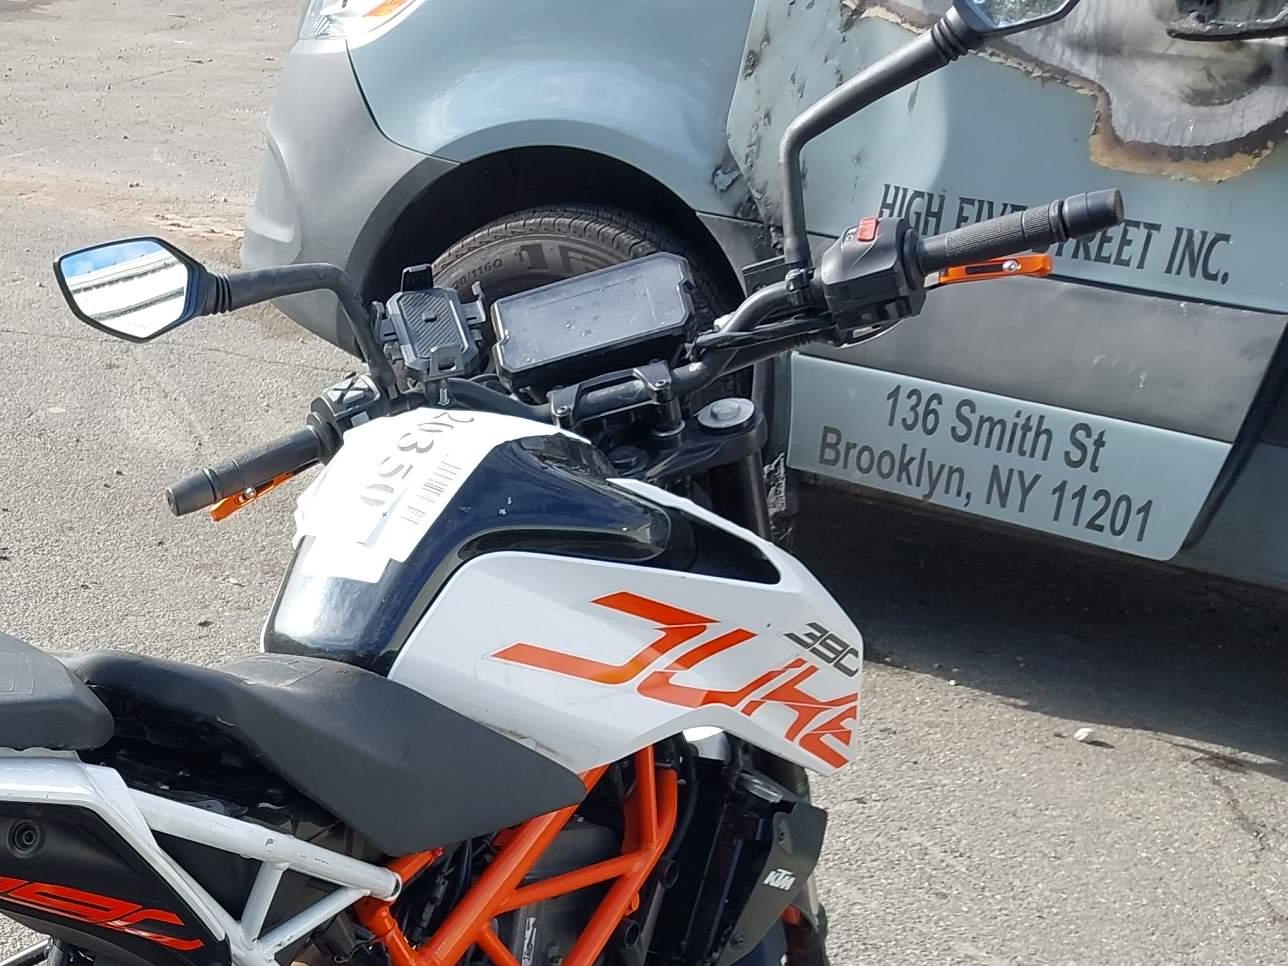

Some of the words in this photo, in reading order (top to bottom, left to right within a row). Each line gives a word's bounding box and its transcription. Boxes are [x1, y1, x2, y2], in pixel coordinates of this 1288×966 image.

[878, 183, 946, 236] HIGH
[956, 197, 1028, 230] FIV
[1165, 226, 1232, 285] INC.
[886, 384, 943, 436] 136
[950, 398, 1053, 461] Smith
[1063, 422, 1106, 473] St
[819, 425, 971, 507] Brooklyn,
[985, 464, 1042, 513] NY
[1051, 479, 1153, 542] 11201
[488, 590, 859, 770] DUKE
[763, 868, 797, 891] KTM
